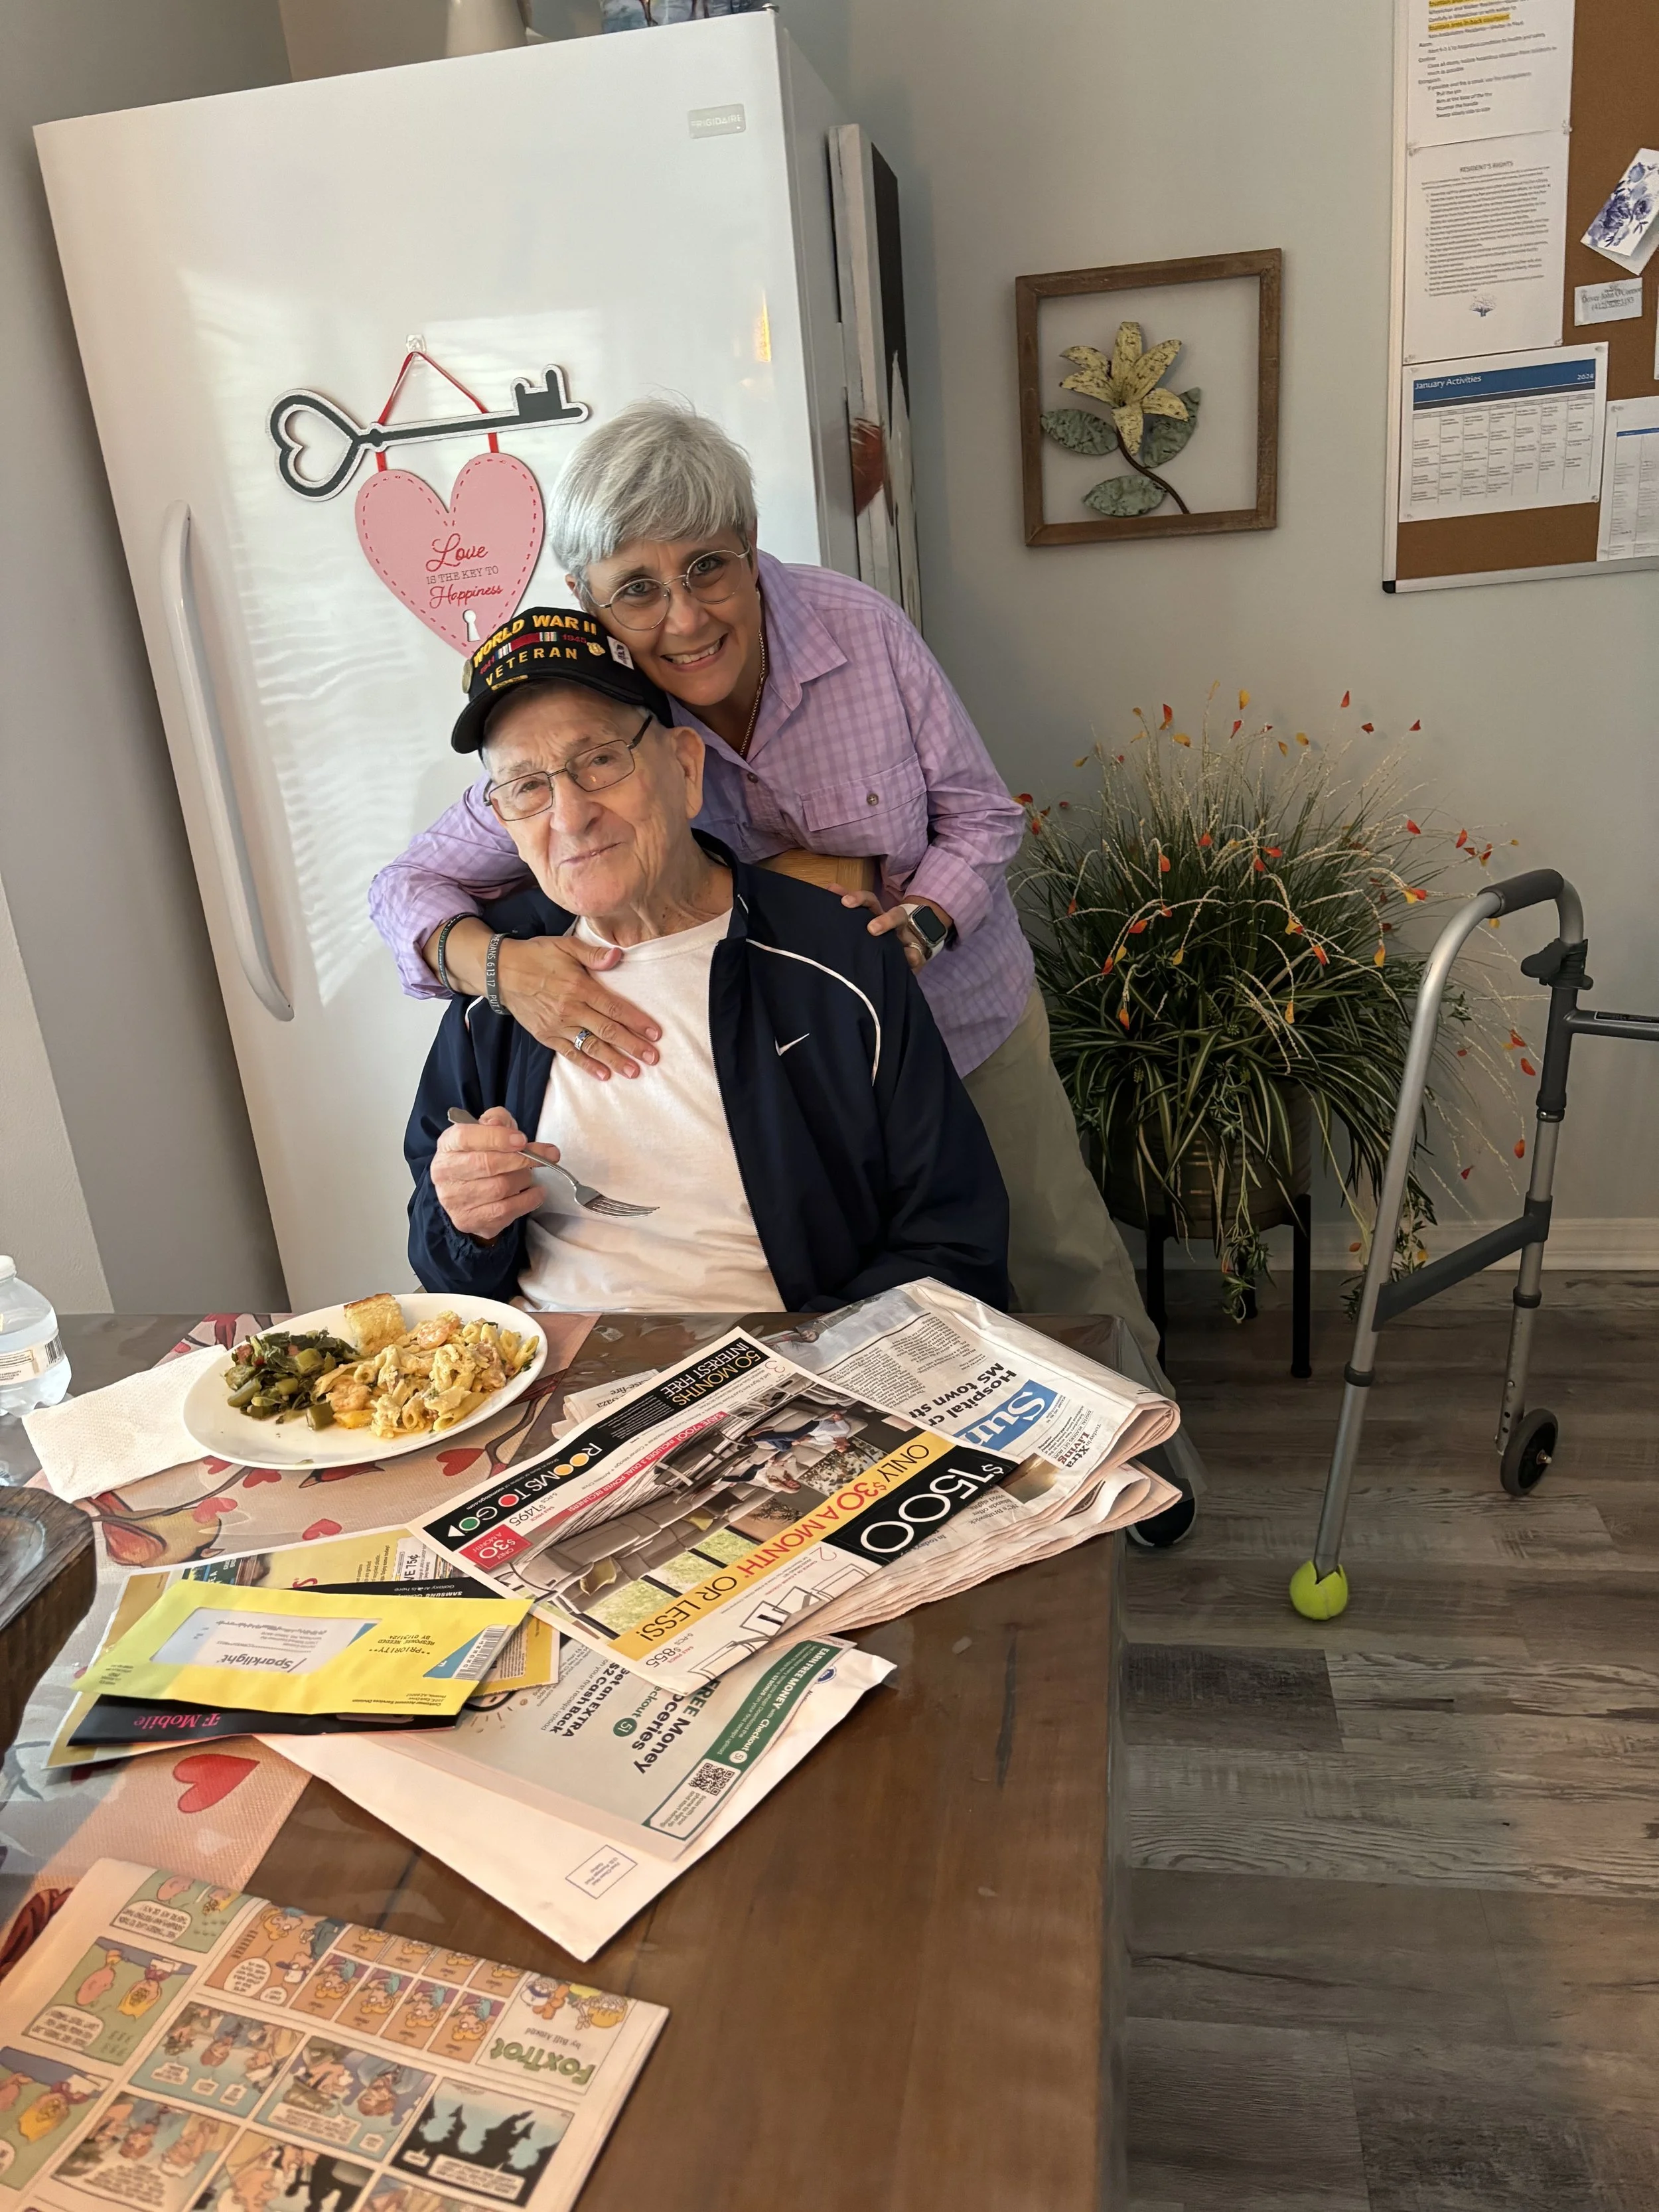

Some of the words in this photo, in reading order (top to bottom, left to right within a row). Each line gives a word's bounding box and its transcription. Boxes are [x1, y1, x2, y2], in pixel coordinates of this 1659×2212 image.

[691, 114, 743, 127] FRIGIDAIRE
[1460, 163, 1492, 173] RESIDENT'S
[1415, 378, 1445, 391] January
[1446, 375, 1482, 386] Activities
[426, 533, 488, 572] Love
[427, 575, 436, 584] IS
[438, 572, 460, 583] THE
[462, 568, 482, 579] KEY
[485, 565, 498, 575] TO
[429, 584, 503, 609] Happiness
[474, 619, 525, 668] WORLD
[533, 615, 579, 630] WAR
[583, 621, 597, 635] II
[562, 634, 587, 644] 1945
[485, 647, 578, 686] VETERAN
[692, 1342, 750, 1379] INTEREST
[735, 1350, 761, 1368] 50
[977, 1363, 1005, 1384] MS
[672, 1364, 739, 1406] MONTHS
[932, 1382, 978, 1406] town
[946, 1370, 1017, 1418] Hospital
[700, 1410, 725, 1426] SAVE
[960, 1391, 1045, 1446] Sun
[1080, 1410, 1092, 1425] DIGITAL
[674, 1422, 703, 1441] $700!
[1068, 1425, 1083, 1443] READERS
[1088, 1422, 1102, 1441] Today
[644, 1438, 675, 1462] INCLUDES
[1052, 1449, 1064, 1459] MORE
[1057, 1432, 1090, 1465] Living
[1065, 1444, 1090, 1468] Xtra
[524, 1443, 603, 1491] ROOMS
[623, 1460, 642, 1476] DUAL
[877, 1444, 930, 1483] ONLY
[602, 1471, 626, 1491] POWER
[465, 1485, 504, 1511] roomstogo.com
[498, 1489, 532, 1508] TO
[836, 1481, 887, 1514] $30
[1001, 1503, 1019, 1511] NC's
[509, 1505, 546, 1526] $1495
[818, 1505, 839, 1520] A
[860, 1464, 1004, 1553] $1500
[459, 1506, 498, 1536] GO
[478, 1539, 516, 1559] $30
[496, 1548, 514, 1560] ONLY
[405, 1554, 421, 1570] 75¢
[697, 1576, 737, 1601] OR
[635, 1599, 701, 1642] LESS!
[221, 1653, 293, 1671] Sparklight
[645, 1647, 682, 1668] $855
[808, 1647, 830, 1664] EARN
[589, 1666, 601, 1680] your
[603, 1662, 620, 1676] $2
[794, 1662, 814, 1678] FREE
[576, 1676, 607, 1705] Cash
[577, 1679, 591, 1690] first
[595, 1686, 613, 1701] an
[759, 1679, 774, 1696] BONUS
[768, 1684, 778, 1693] you
[772, 1677, 800, 1710] MONEY
[559, 1690, 580, 1711] receipt
[631, 1685, 662, 1718] eckout
[682, 1683, 717, 1720] FREE
[747, 1701, 758, 1714] your
[133, 1714, 202, 1730] Mobile
[540, 1710, 561, 1731] upload
[549, 1706, 582, 1733] Back
[561, 1702, 601, 1737] EXTRA
[631, 1693, 684, 1751] oceries
[741, 1713, 751, 1722] first
[743, 1706, 764, 1730] Download
[766, 1708, 776, 1718] with
[617, 1721, 632, 1733] 51
[729, 1722, 745, 1739] receipt
[737, 1729, 747, 1738] the
[741, 1718, 770, 1751] Checkout
[633, 1718, 691, 1774] Money
[733, 1751, 743, 1761] 51
[524, 2026, 553, 2042] Amend
[552, 2034, 569, 2047] Bill
[569, 2039, 582, 2050] by
[490, 2037, 597, 2086] FoxTrot
